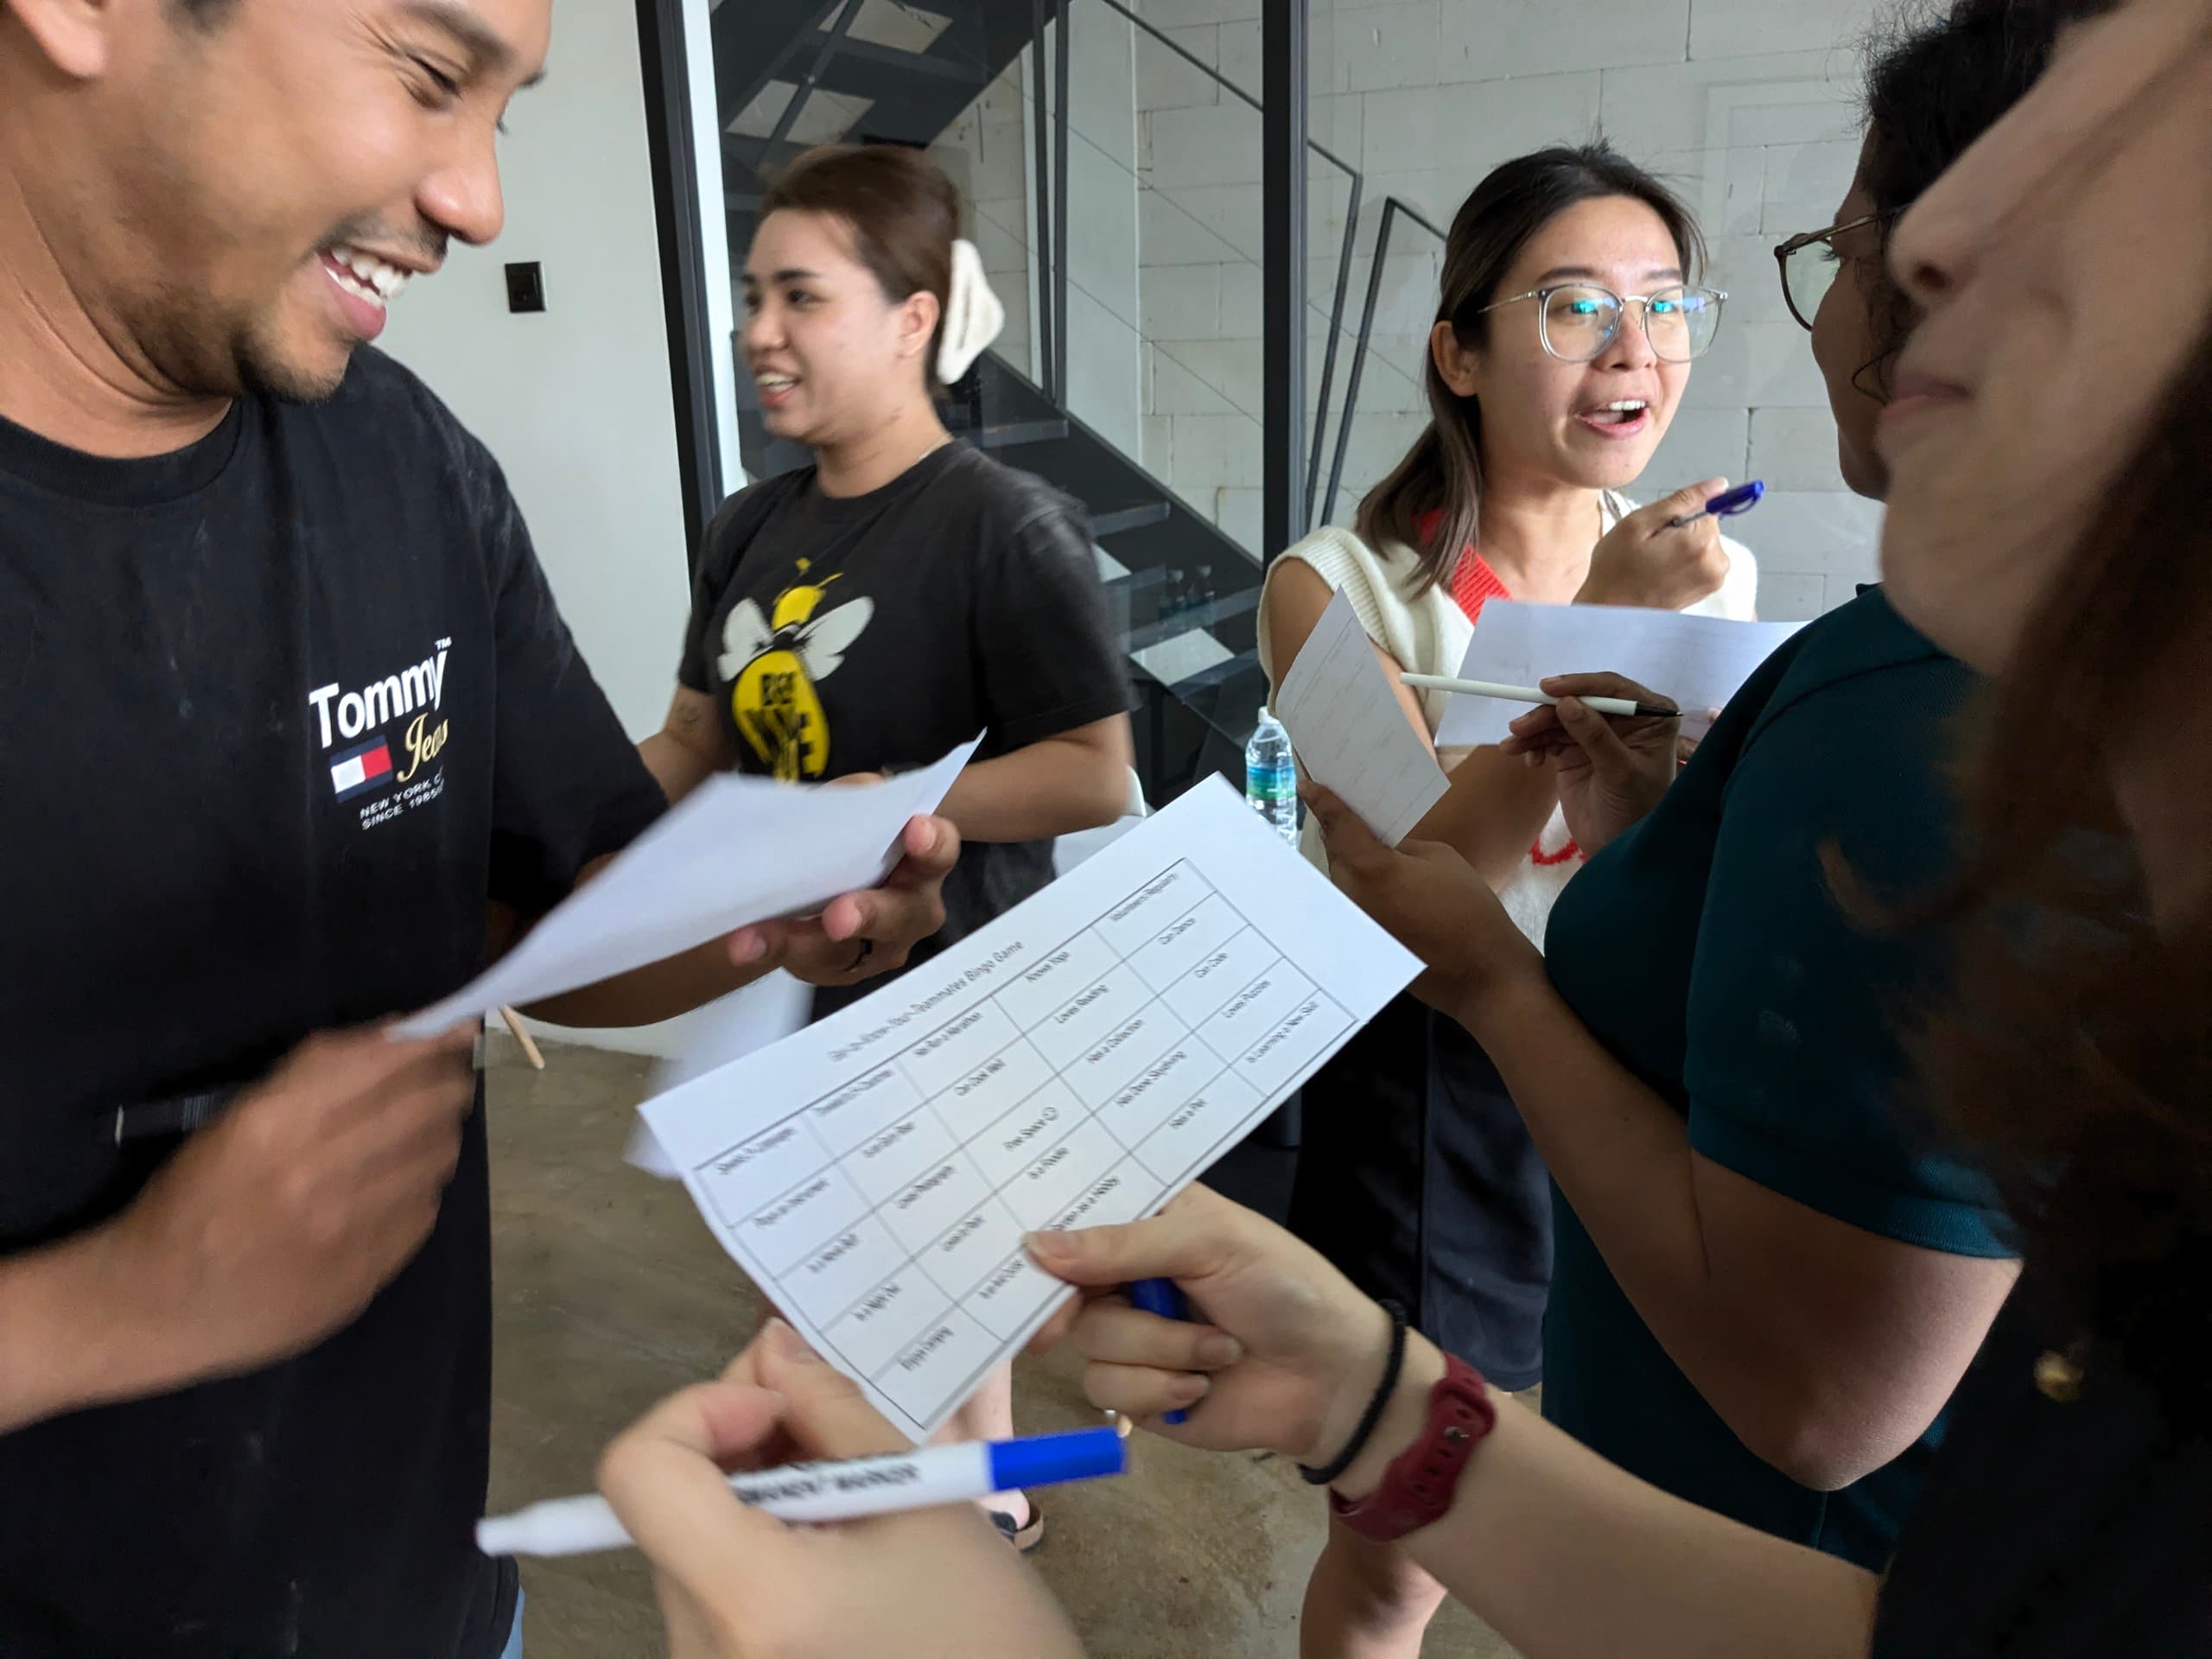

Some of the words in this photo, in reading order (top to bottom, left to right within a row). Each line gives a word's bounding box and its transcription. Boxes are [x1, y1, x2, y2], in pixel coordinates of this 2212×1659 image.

[308, 650, 448, 749] Tommy
[359, 797, 390, 819] NEW
[361, 804, 404, 830] SINCE
[963, 959, 997, 982] Bingo
[991, 940, 1023, 961] Game
[1053, 1004, 1080, 1023] Loves
